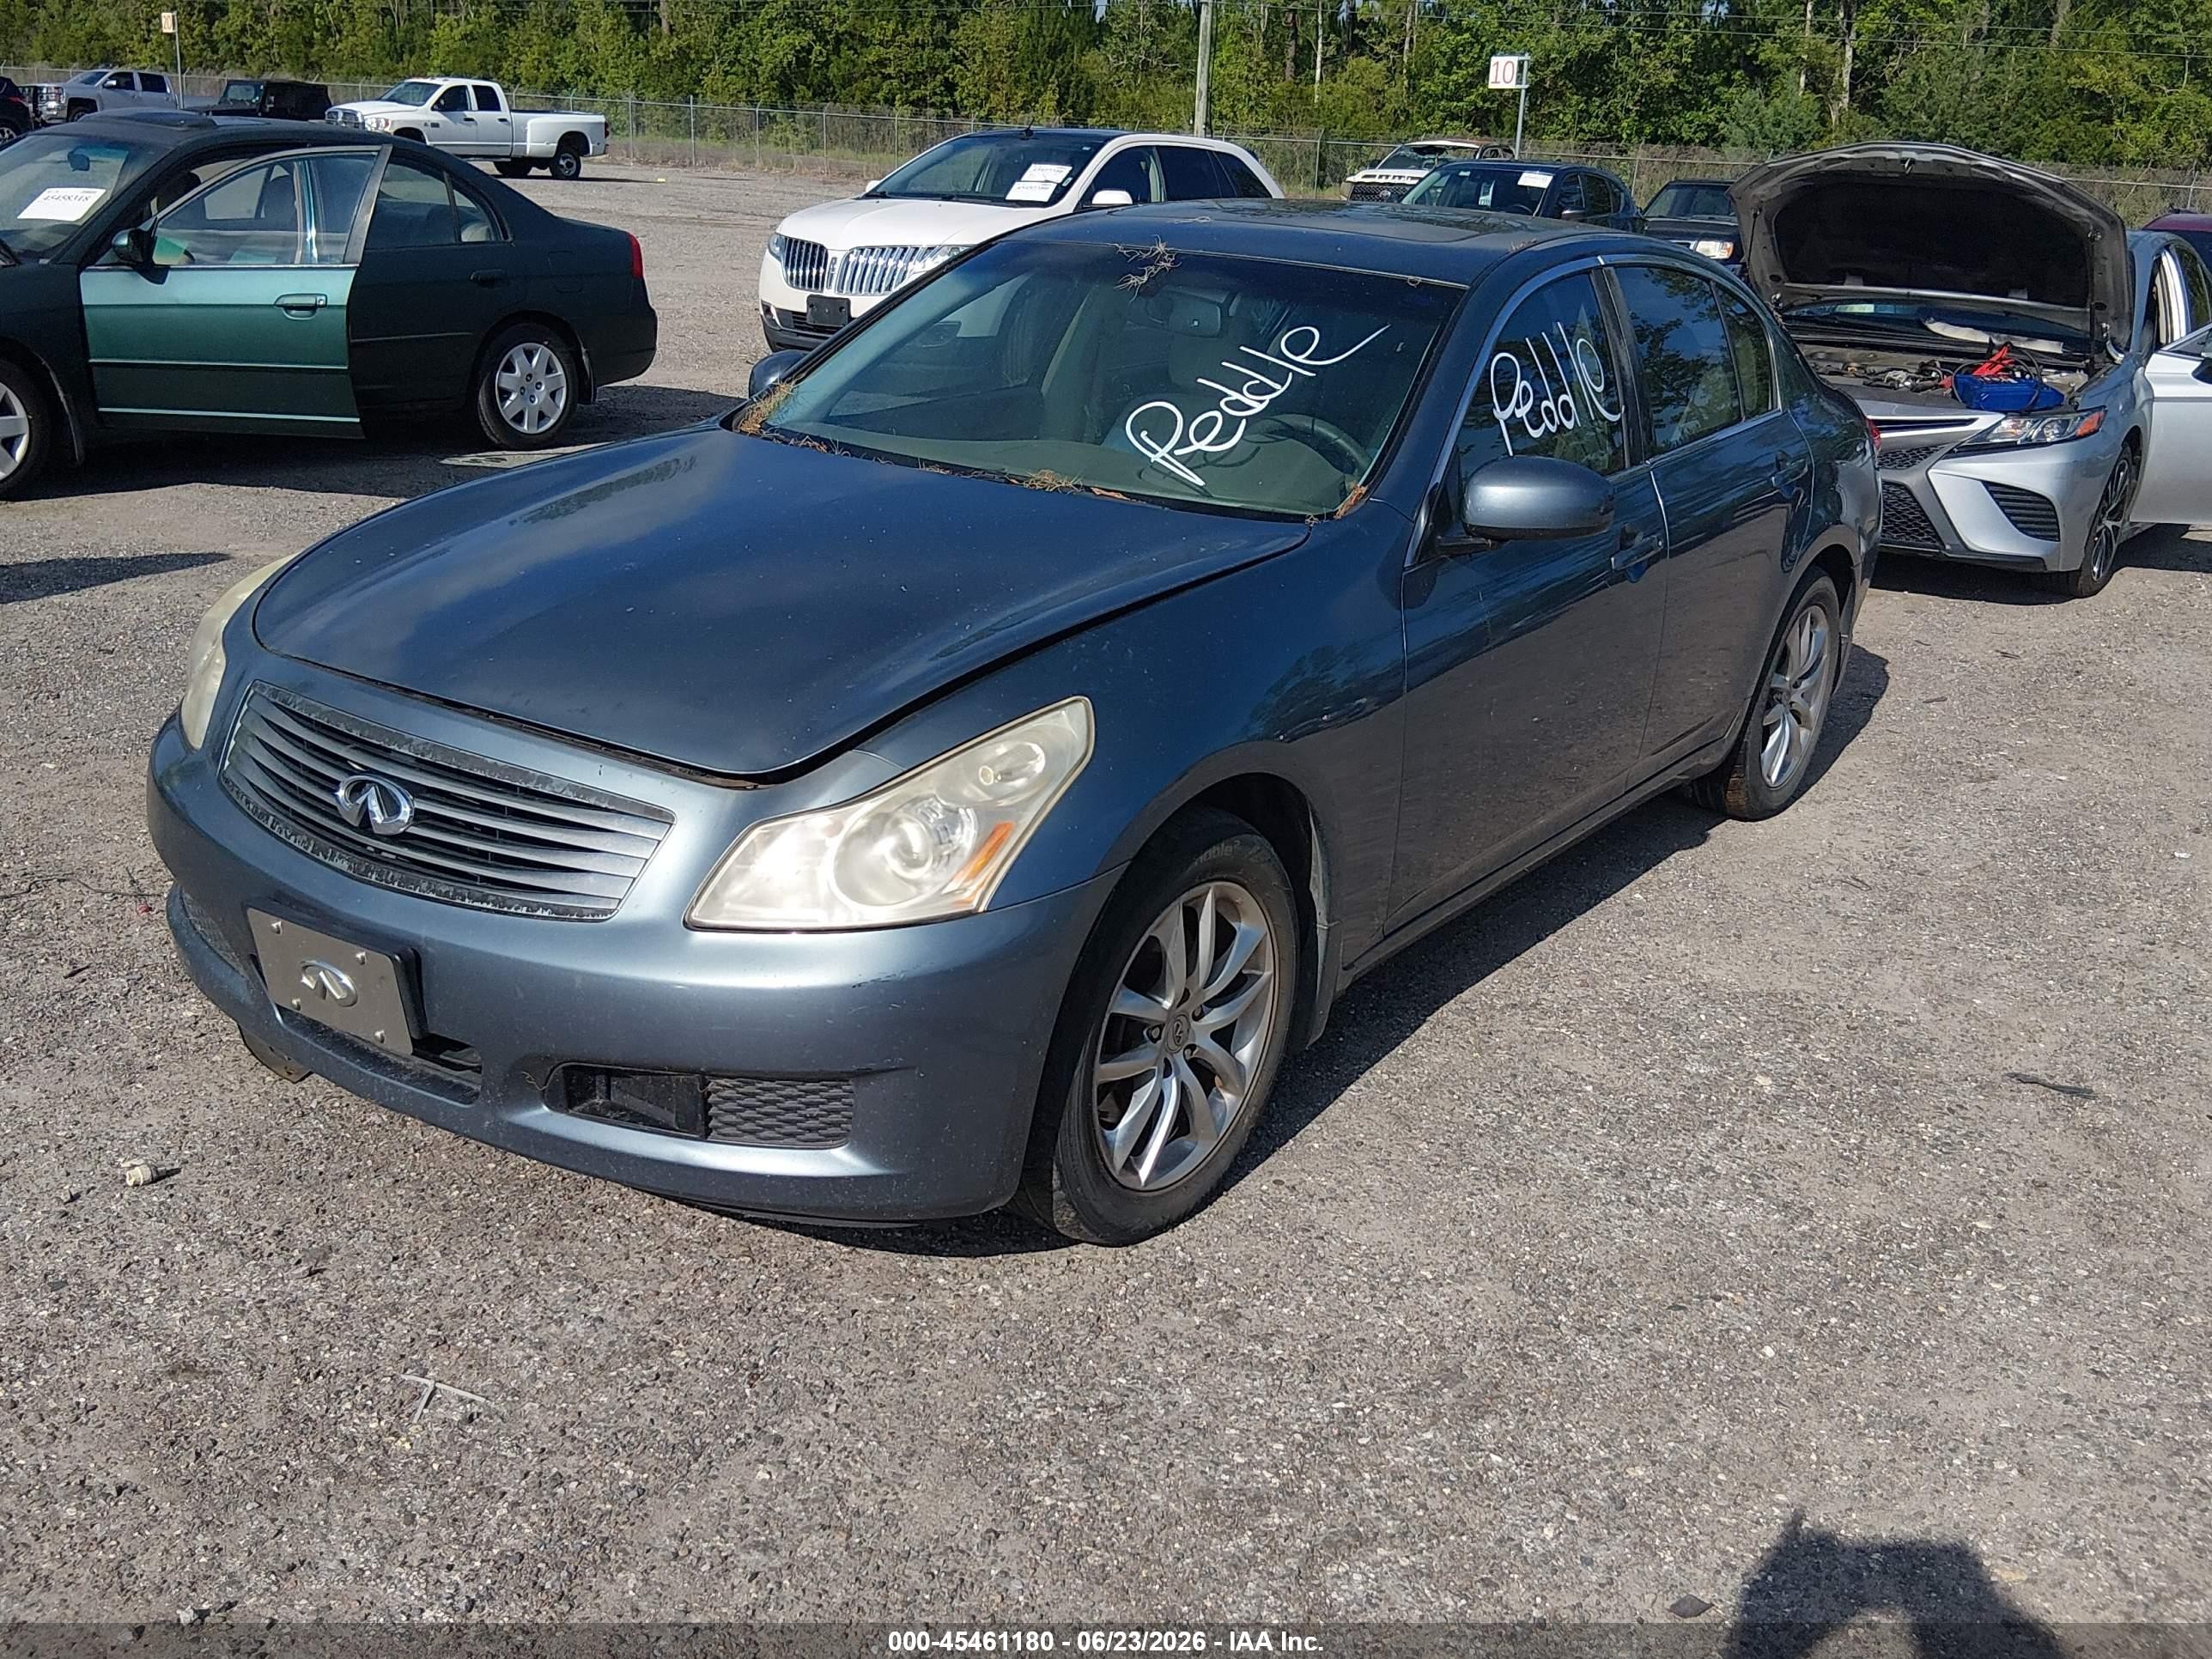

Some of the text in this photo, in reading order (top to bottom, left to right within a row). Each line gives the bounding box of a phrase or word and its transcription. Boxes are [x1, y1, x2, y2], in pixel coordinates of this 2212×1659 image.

[1491, 60, 1515, 84] 10
[1125, 324, 1391, 487] Peddle
[1490, 321, 1625, 457] Peddle
